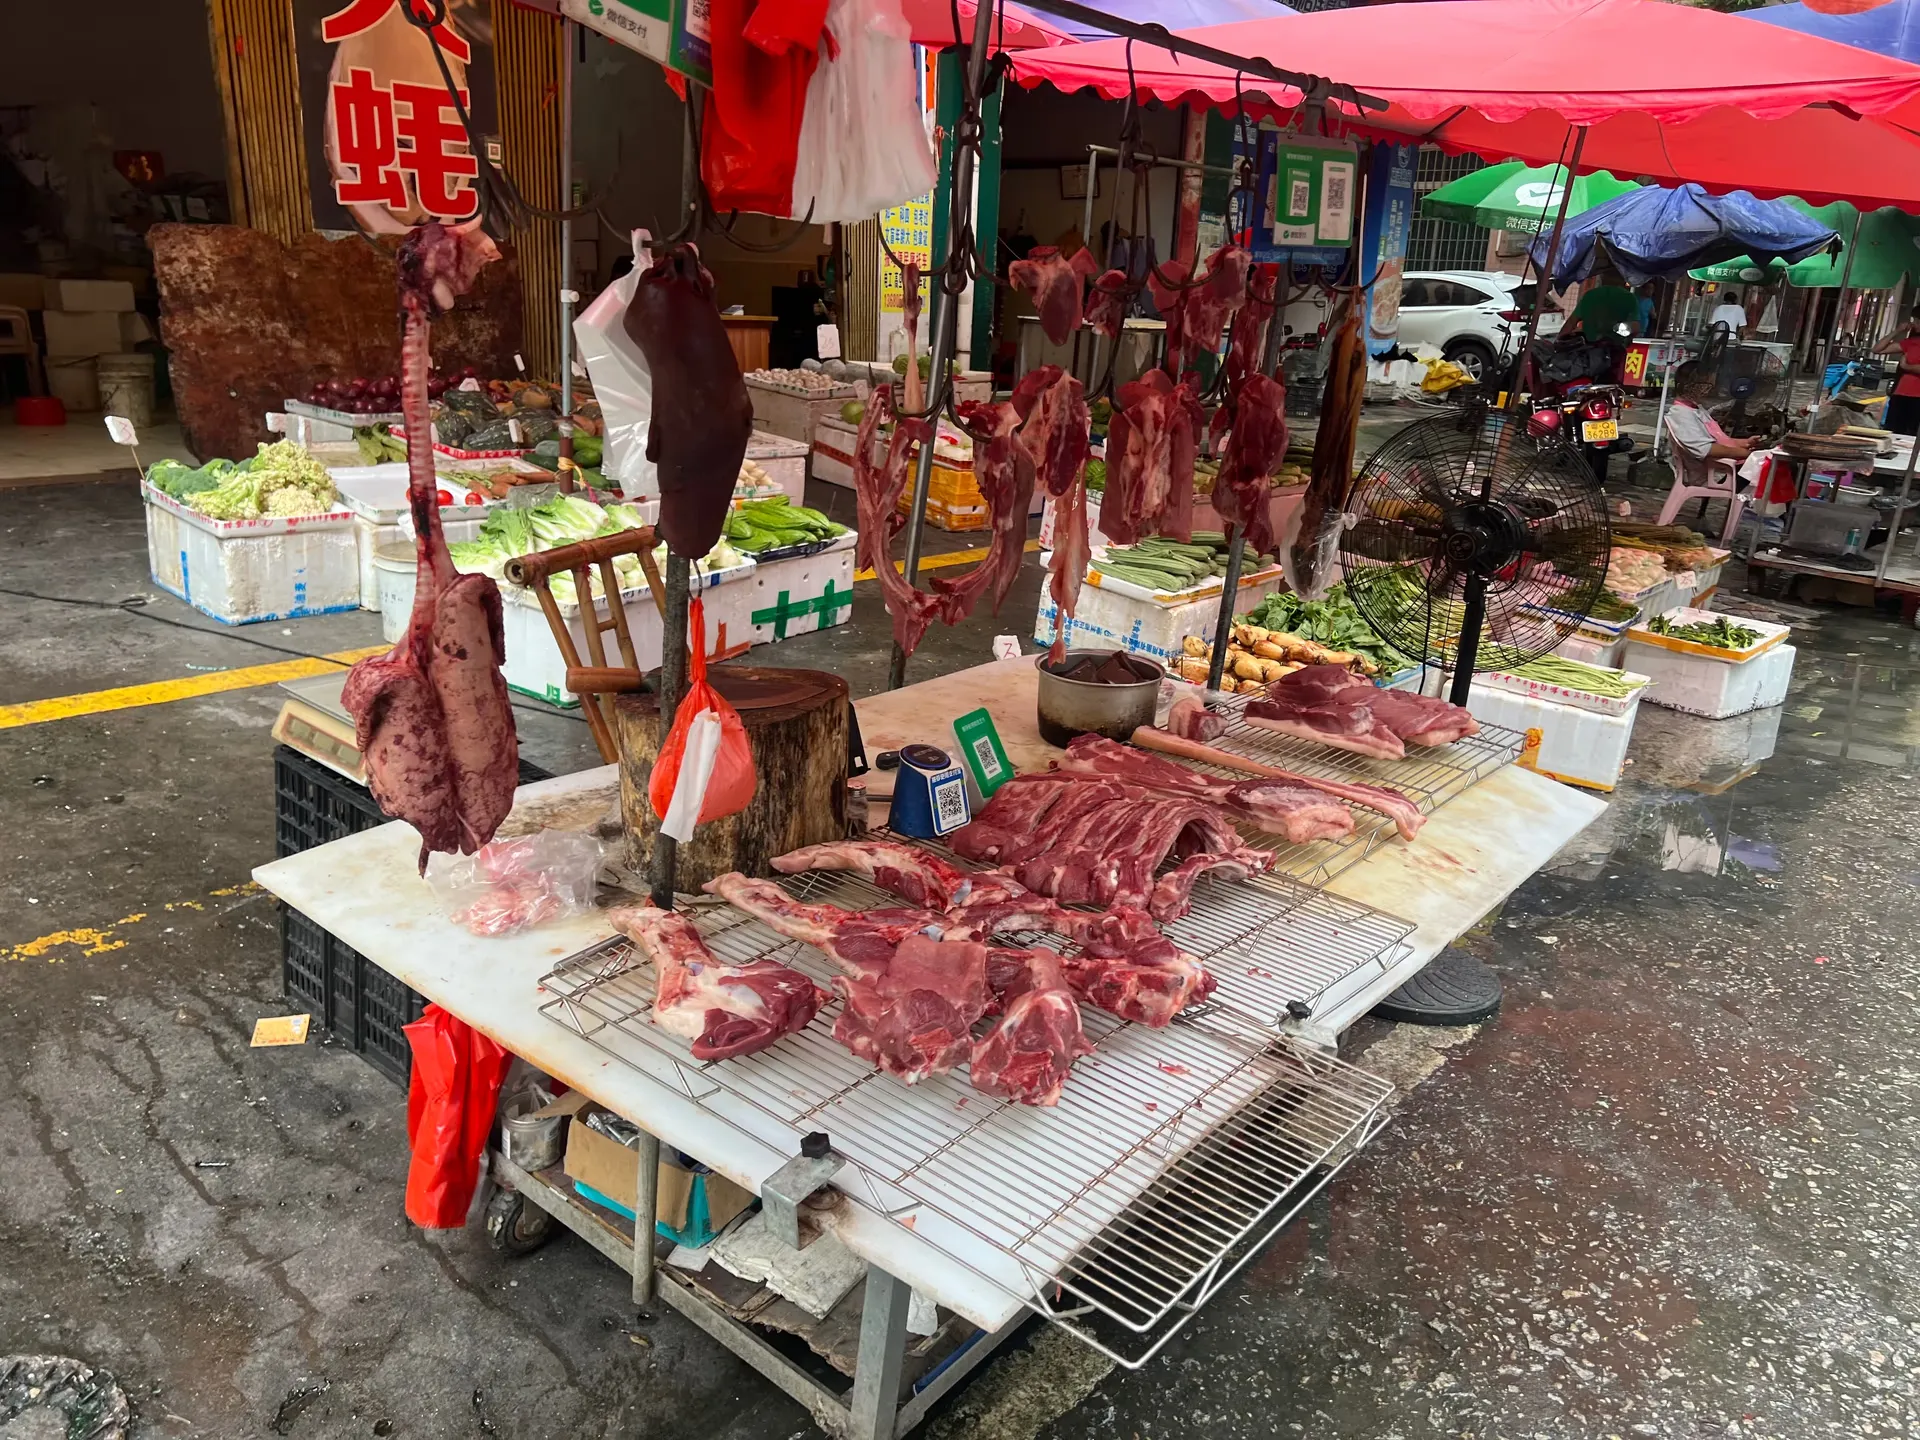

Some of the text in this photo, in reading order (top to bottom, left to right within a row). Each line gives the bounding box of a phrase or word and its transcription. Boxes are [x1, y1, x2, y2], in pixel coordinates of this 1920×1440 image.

[606, 8, 648, 39] 微信支付
[1505, 216, 1553, 233] 微信支付
[1625, 348, 1643, 379] 肉
